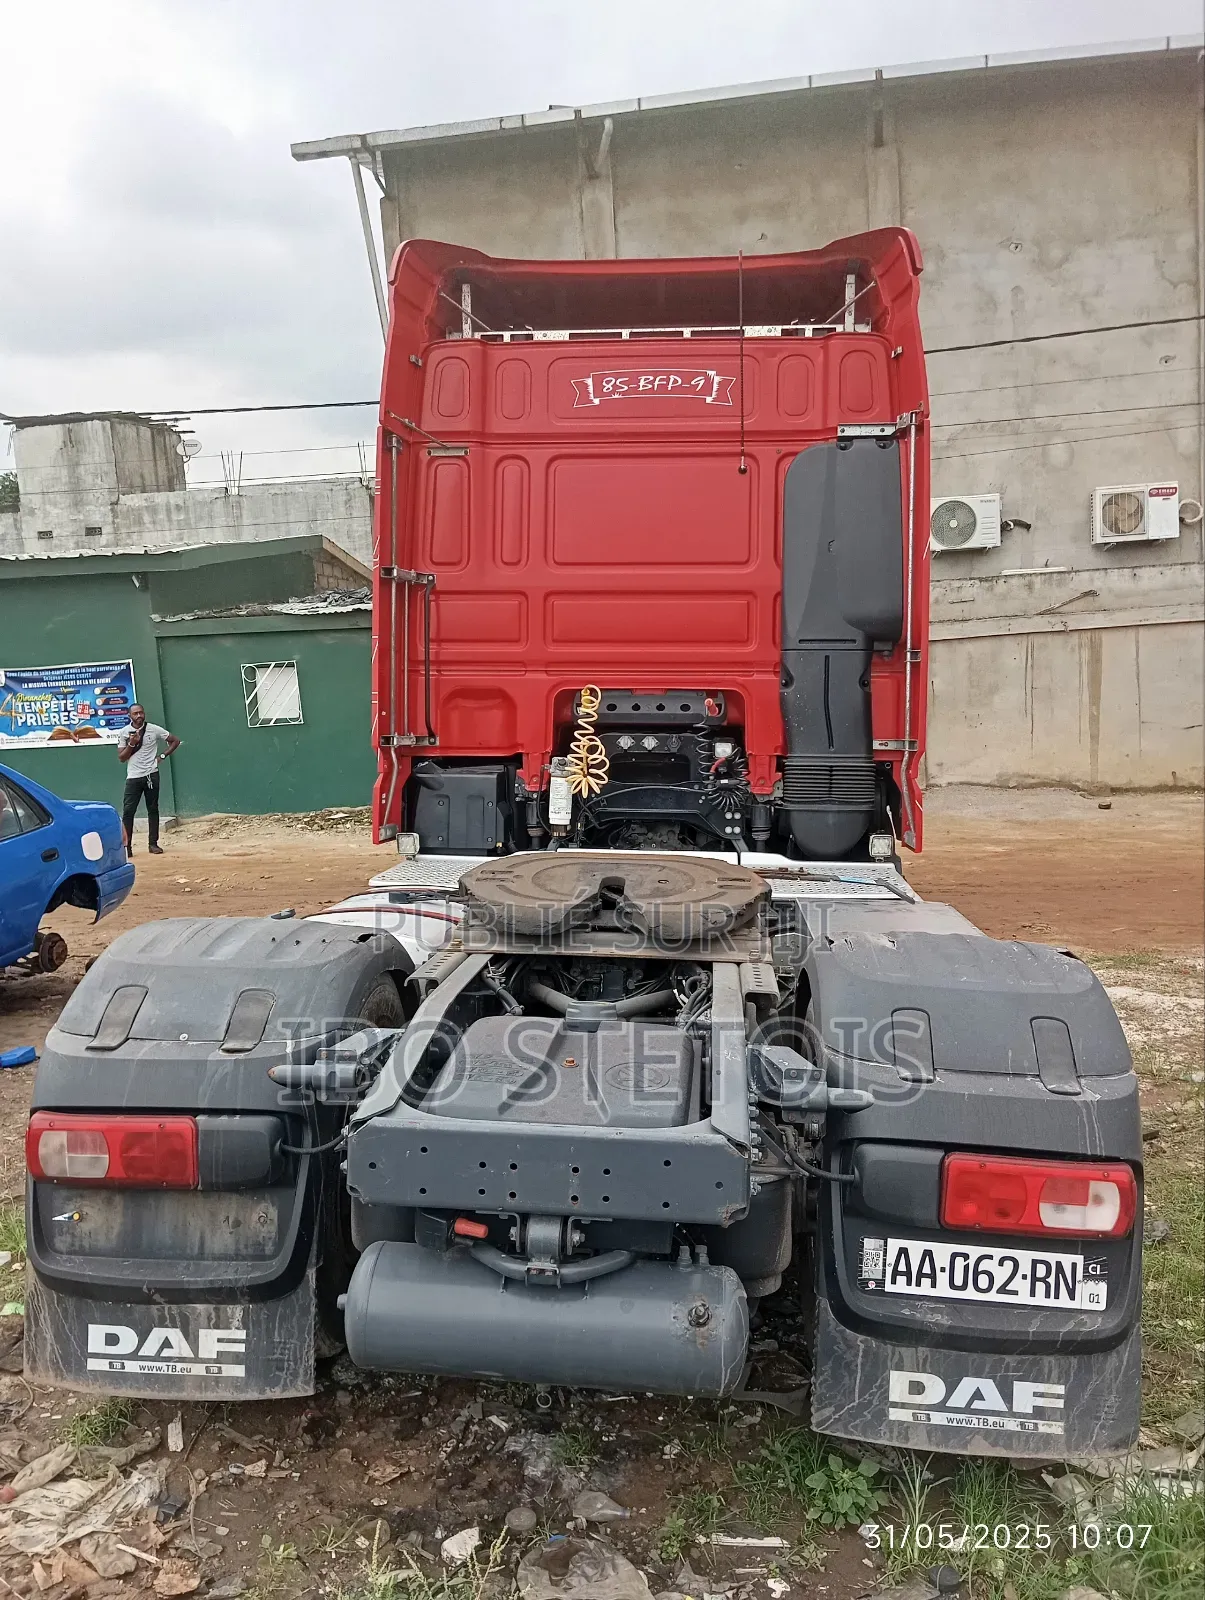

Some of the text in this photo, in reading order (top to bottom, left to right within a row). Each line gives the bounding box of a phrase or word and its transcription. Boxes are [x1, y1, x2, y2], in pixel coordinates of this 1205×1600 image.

[15, 697, 75, 713] TEMPÊTE
[88, 1324, 247, 1359] DAF
[138, 1363, 192, 1374] www.TB.eu
[889, 1370, 1066, 1413] DAF
[946, 1415, 1005, 1429] www.TB.eu
